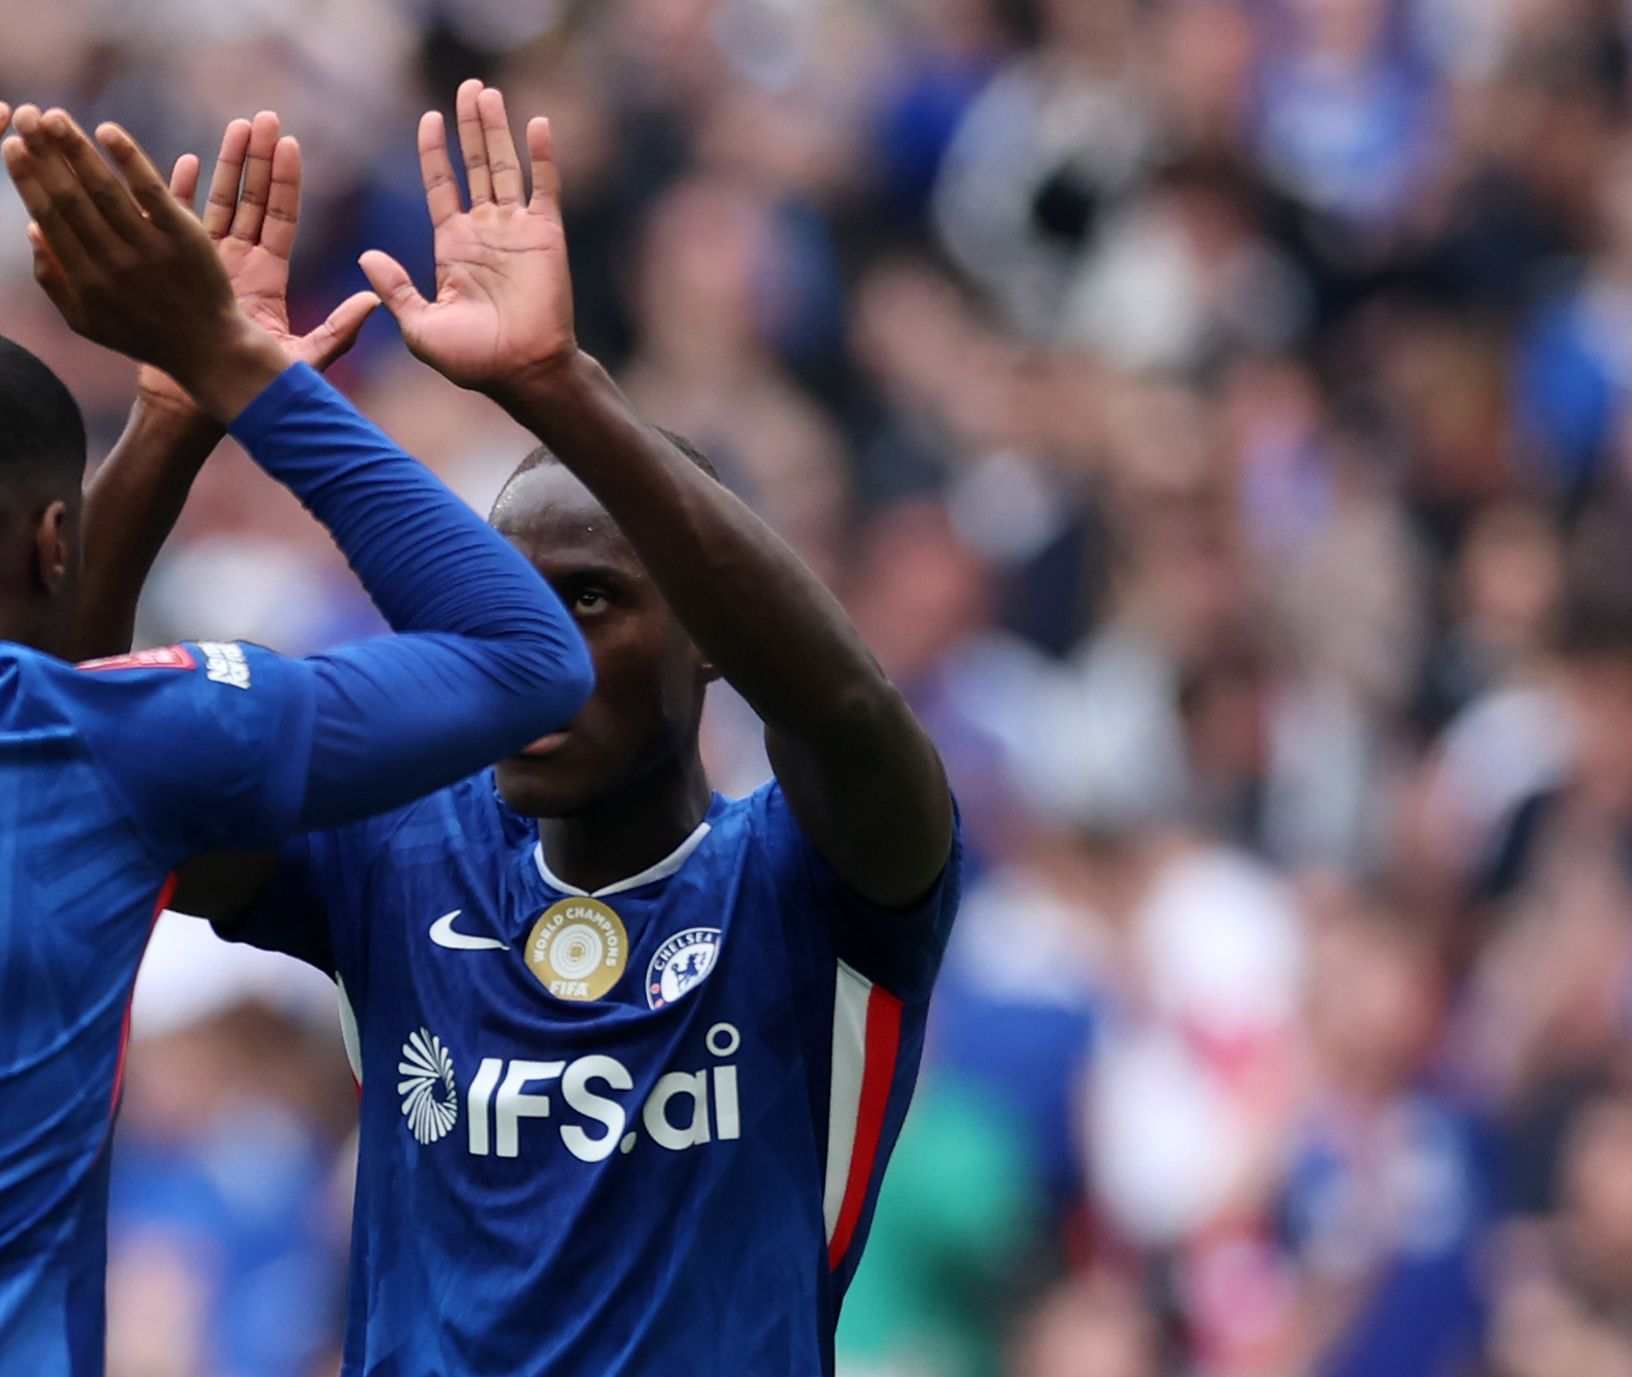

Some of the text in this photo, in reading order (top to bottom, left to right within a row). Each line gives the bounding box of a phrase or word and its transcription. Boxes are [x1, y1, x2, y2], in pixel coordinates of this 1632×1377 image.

[533, 906, 619, 967] WORLD CHAMPIONS
[653, 932, 713, 972] CHELSEA
[549, 979, 589, 997] FIFA
[467, 1022, 741, 1163] IFS.ai
